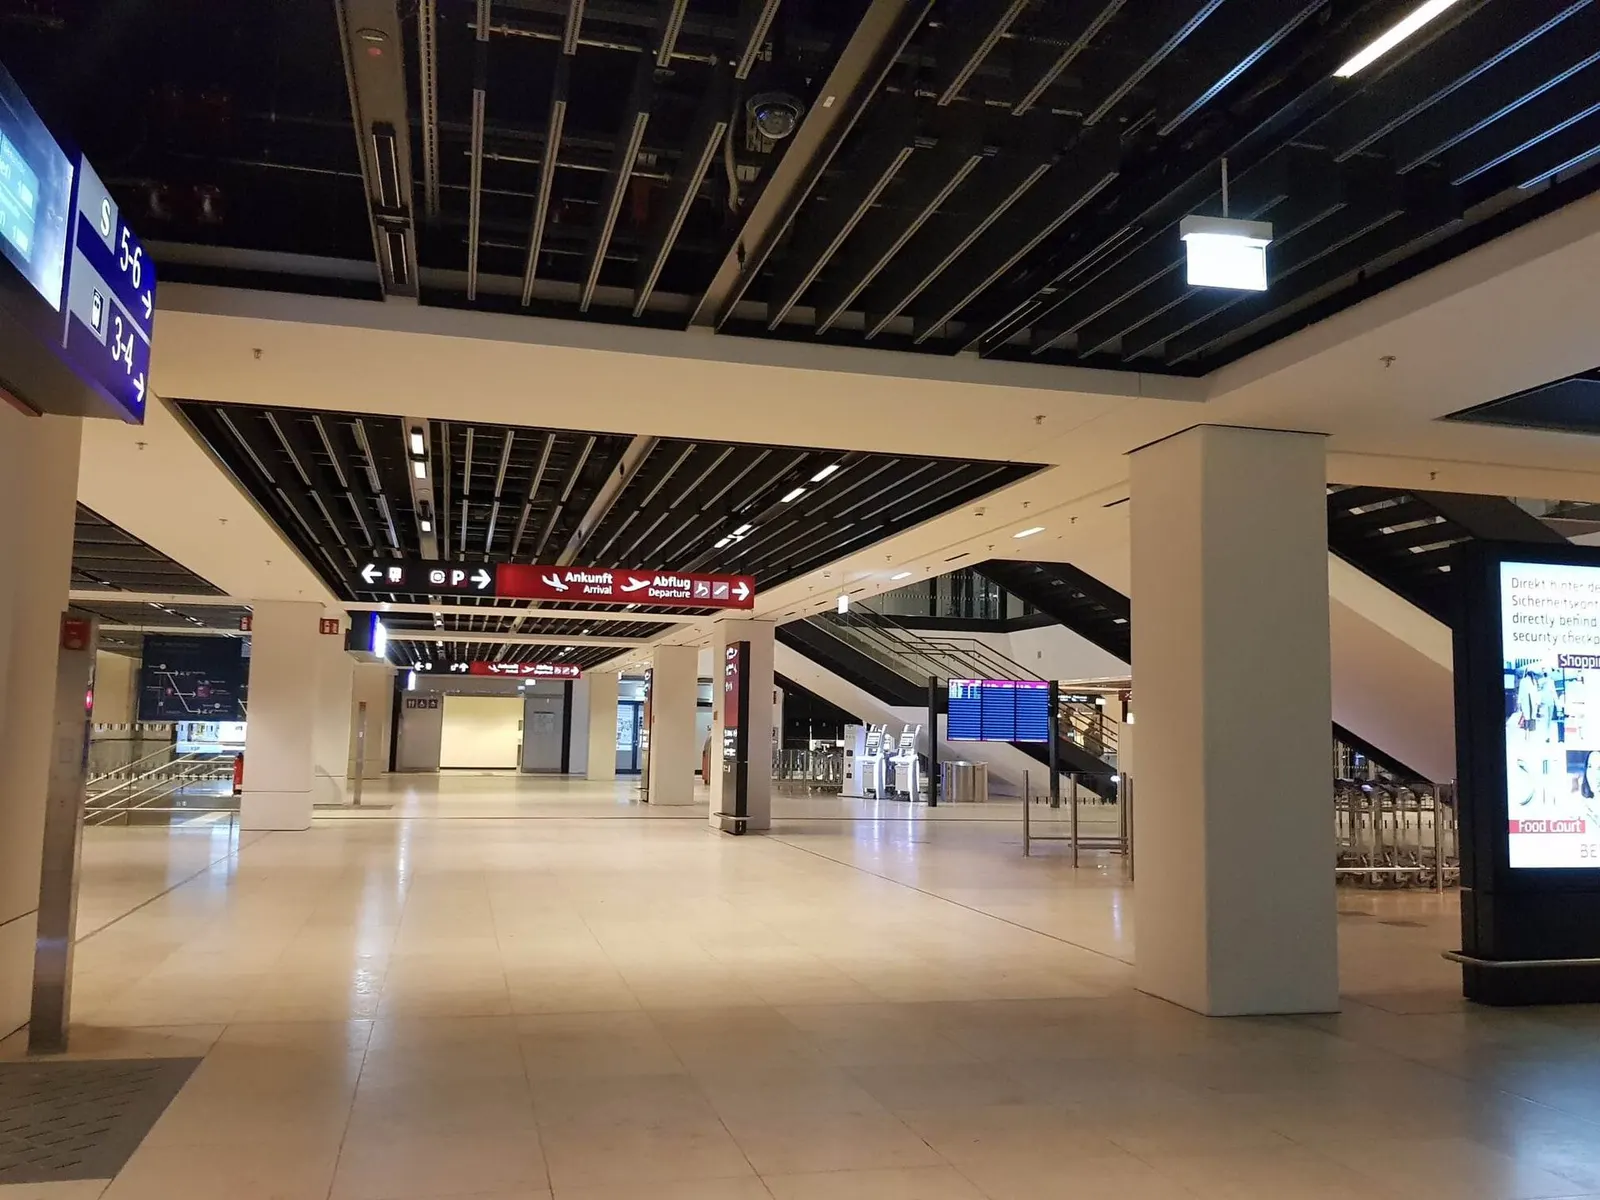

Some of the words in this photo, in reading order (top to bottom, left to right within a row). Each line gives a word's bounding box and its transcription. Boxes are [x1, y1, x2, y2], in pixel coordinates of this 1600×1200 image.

[120, 227, 142, 289] 5-6
[111, 316, 134, 375] 3-4
[452, 570, 465, 586] P
[564, 572, 613, 584] Ankunft
[653, 576, 691, 590] Abflug
[1511, 577, 1545, 590] Direkt
[583, 585, 612, 595] Arrival
[648, 588, 691, 599] Departure
[1512, 612, 1555, 628] directly
[1560, 613, 1597, 628] behind
[1513, 631, 1558, 646] security
[1560, 654, 1600, 669] Shoppi
[1519, 820, 1546, 833] Food
[1550, 820, 1582, 833] Court
[1580, 844, 1600, 859] BE
